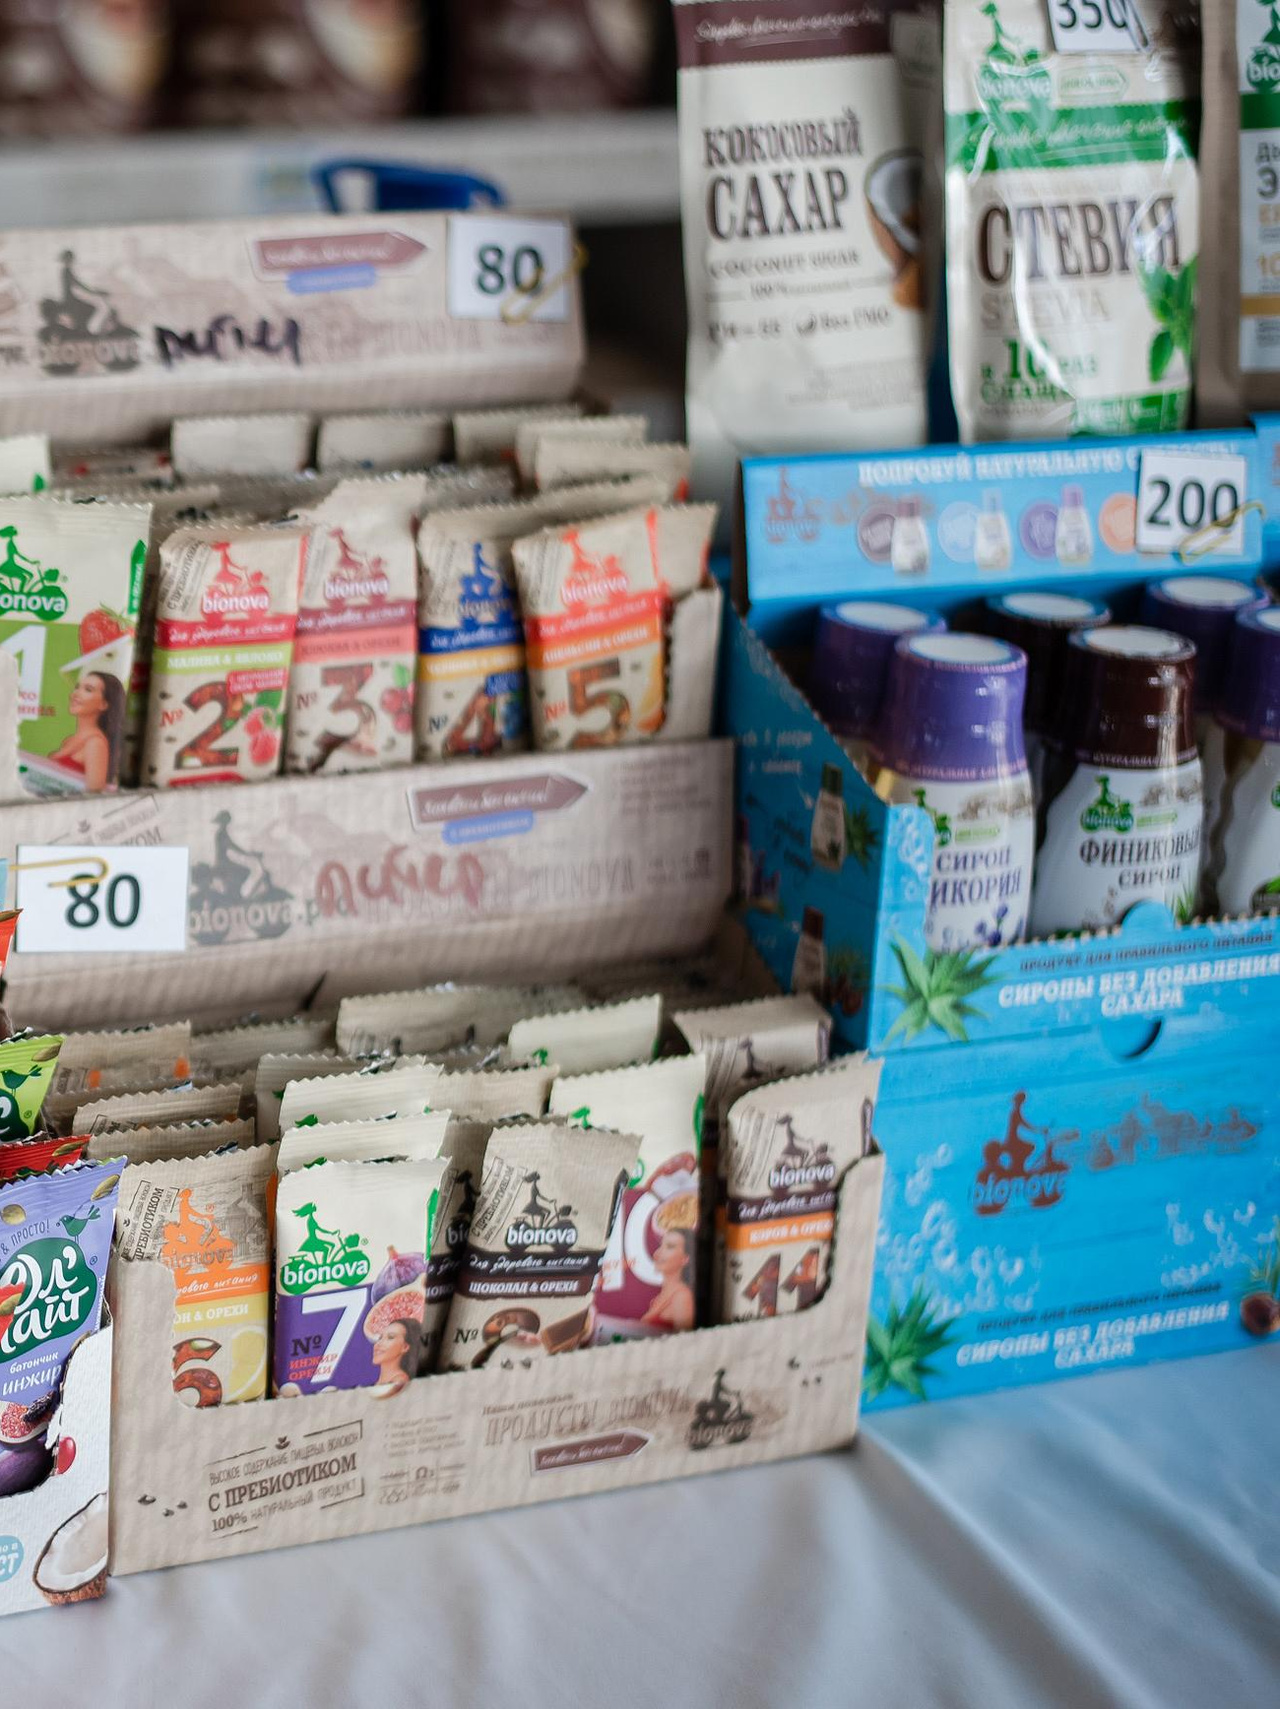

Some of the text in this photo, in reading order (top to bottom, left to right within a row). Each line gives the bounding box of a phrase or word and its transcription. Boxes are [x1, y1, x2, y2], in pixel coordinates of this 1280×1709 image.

[703, 107, 862, 167] КОКОСОВЫЙ
[709, 168, 849, 242] САХАР
[476, 244, 543, 296] 80
[1146, 478, 1240, 529] 200
[202, 590, 270, 614] bionova
[567, 658, 629, 749] 5
[174, 680, 241, 770] 2
[936, 844, 1012, 872] СИРОП
[1118, 866, 1181, 890] СИРОП
[64, 874, 141, 929] 80
[999, 953, 1280, 1008] СИРОПЫ БЕЗ ДОБАВЛЕНИЯ
[1101, 988, 1184, 1017] САХАРА
[770, 1164, 834, 1187] bionova
[11, 1220, 50, 1246] ПРОСТО!
[507, 1224, 577, 1244] bionova
[283, 1258, 370, 1285] bionova
[469, 1280, 579, 1292] ШОКОЛАД ОРЕХИ
[206, 1303, 249, 1319] ОРЕХИ
[301, 1287, 367, 1385] 7
[957, 1300, 1230, 1368] СИРОПЫ БЕЗ ДОБАВЛЕНИЯ
[9, 1351, 59, 1374] батончик
[1054, 1341, 1135, 1371] САХАРА
[2, 1365, 62, 1397] инжир
[208, 1492, 220, 1512] С
[224, 1452, 357, 1510] ПРЕБИОТИКОМ
[211, 1512, 247, 1532] 100%
